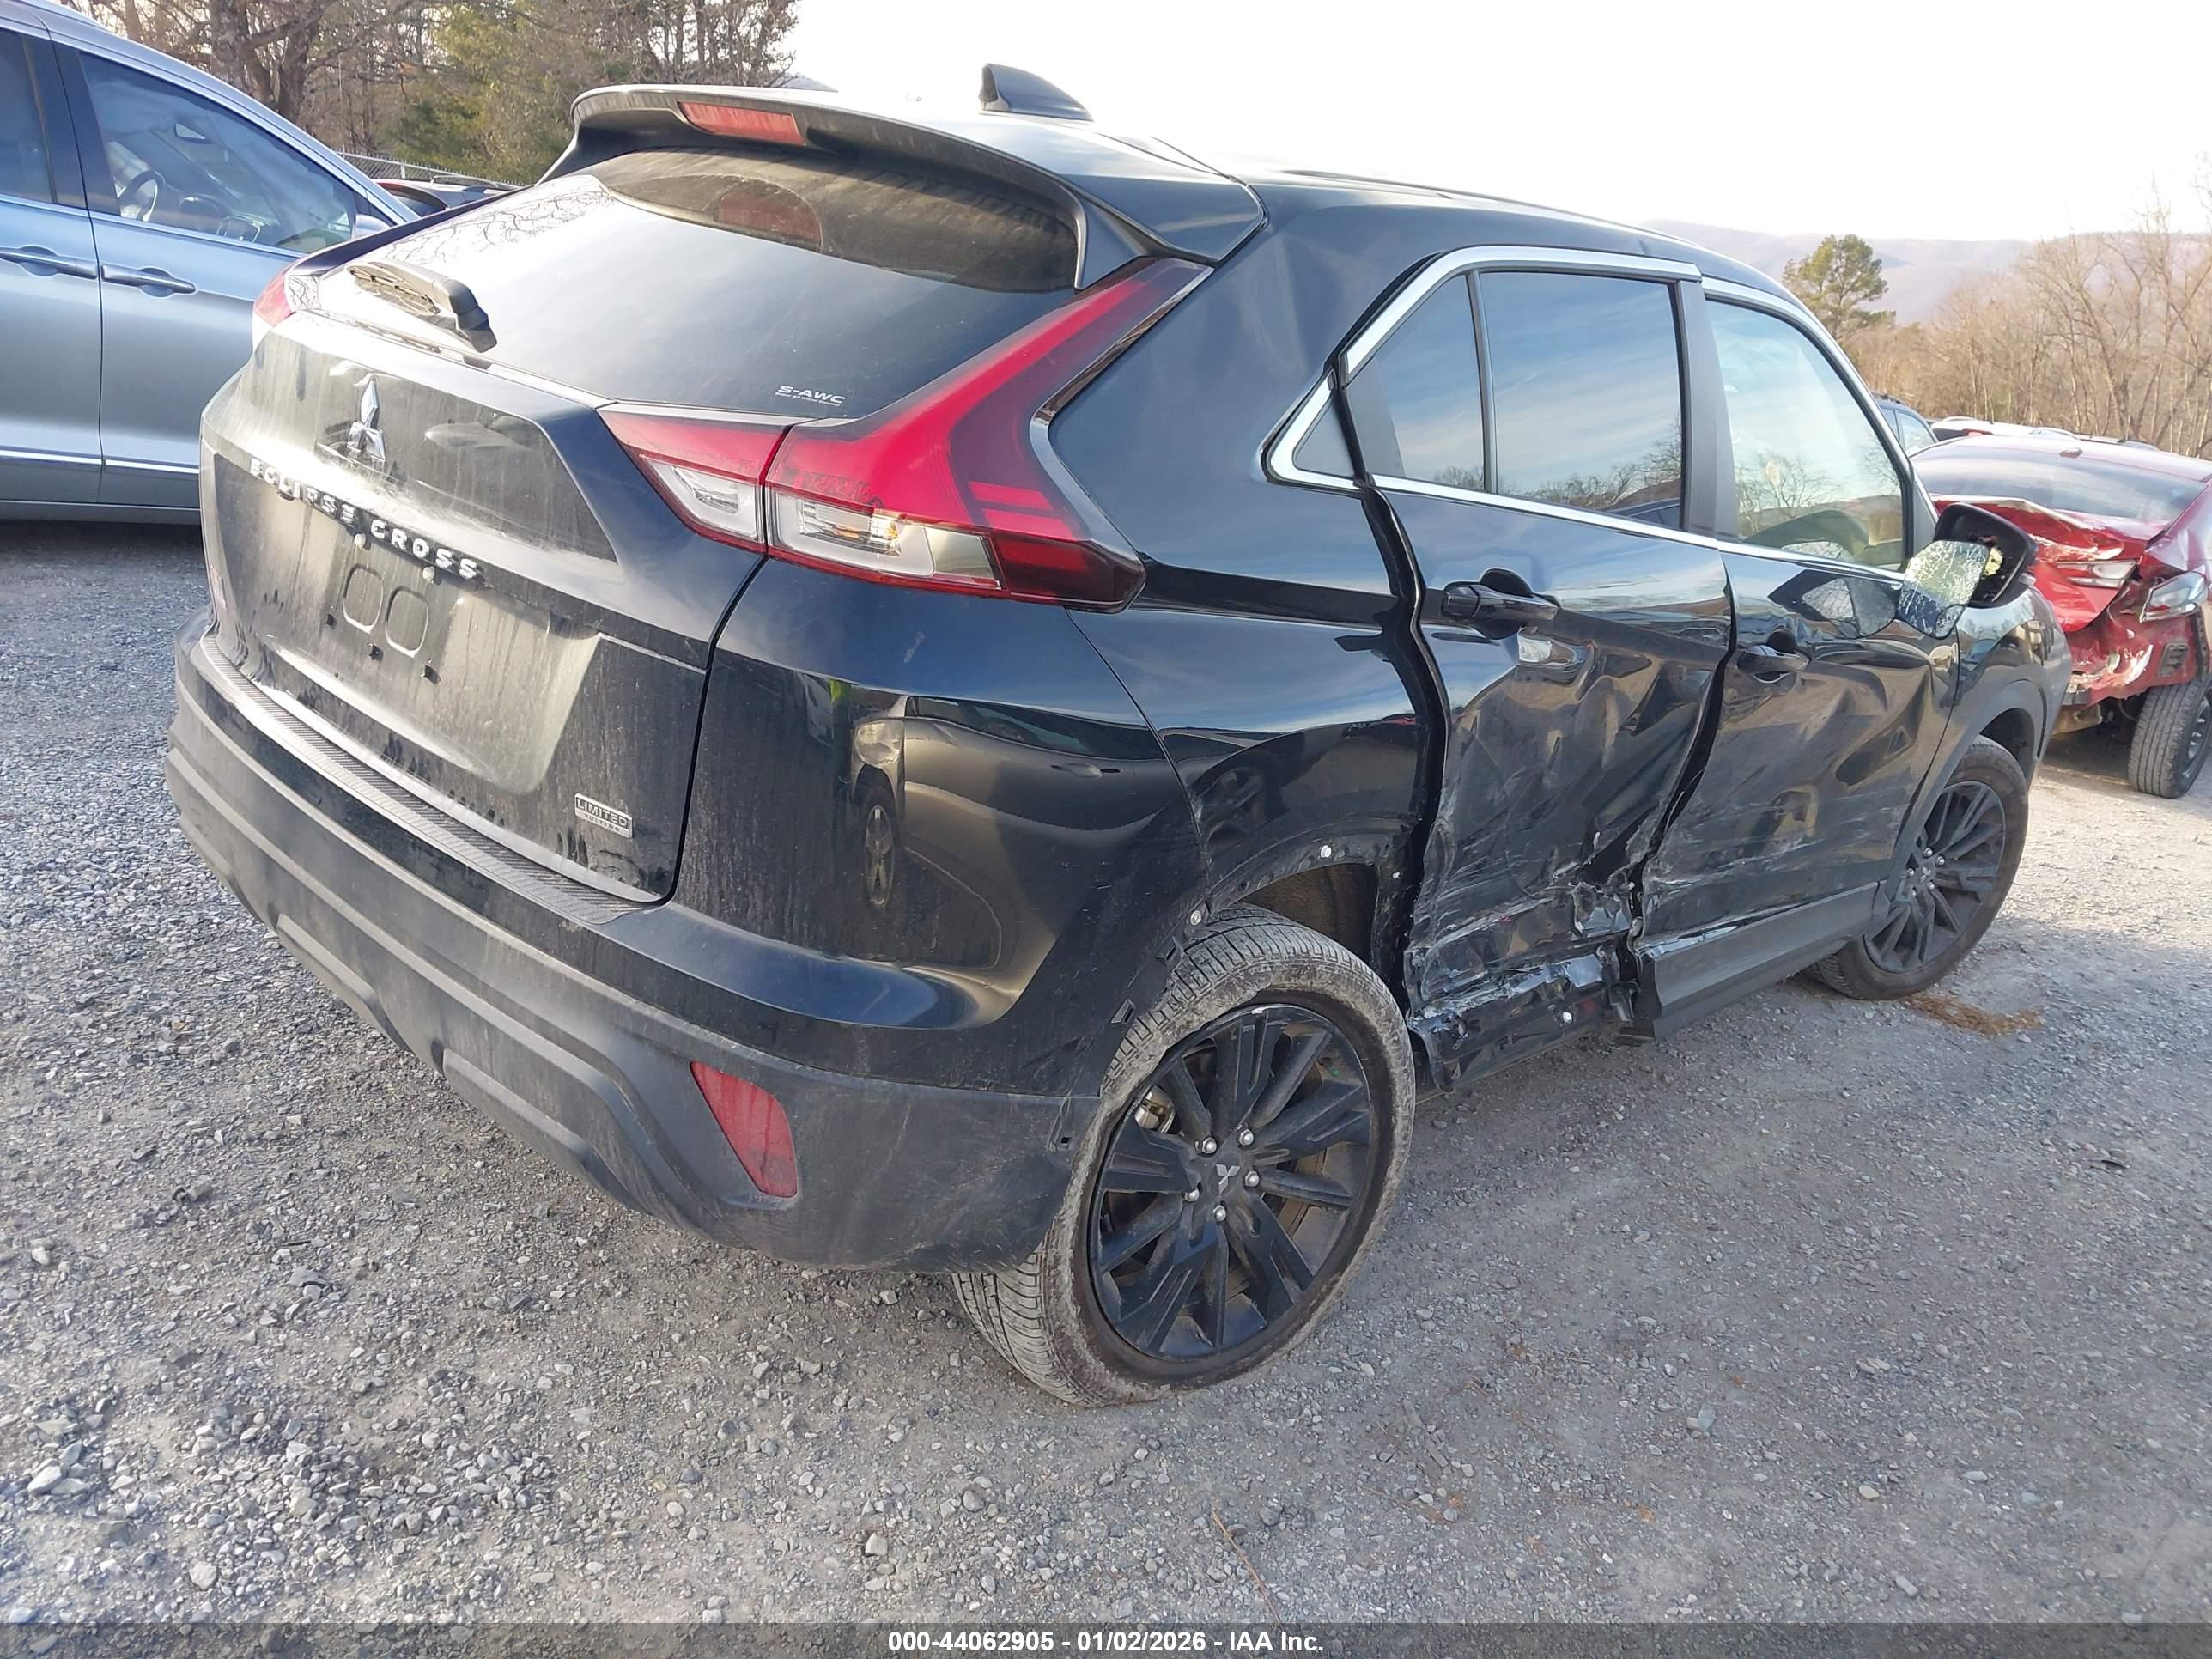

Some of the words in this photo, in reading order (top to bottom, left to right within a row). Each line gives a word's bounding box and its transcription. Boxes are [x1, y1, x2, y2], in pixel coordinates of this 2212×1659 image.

[778, 386, 846, 404] S-AWC
[250, 458, 356, 525] ECLIPSE
[371, 519, 477, 579] CROSS
[578, 799, 628, 826] LIMITED
